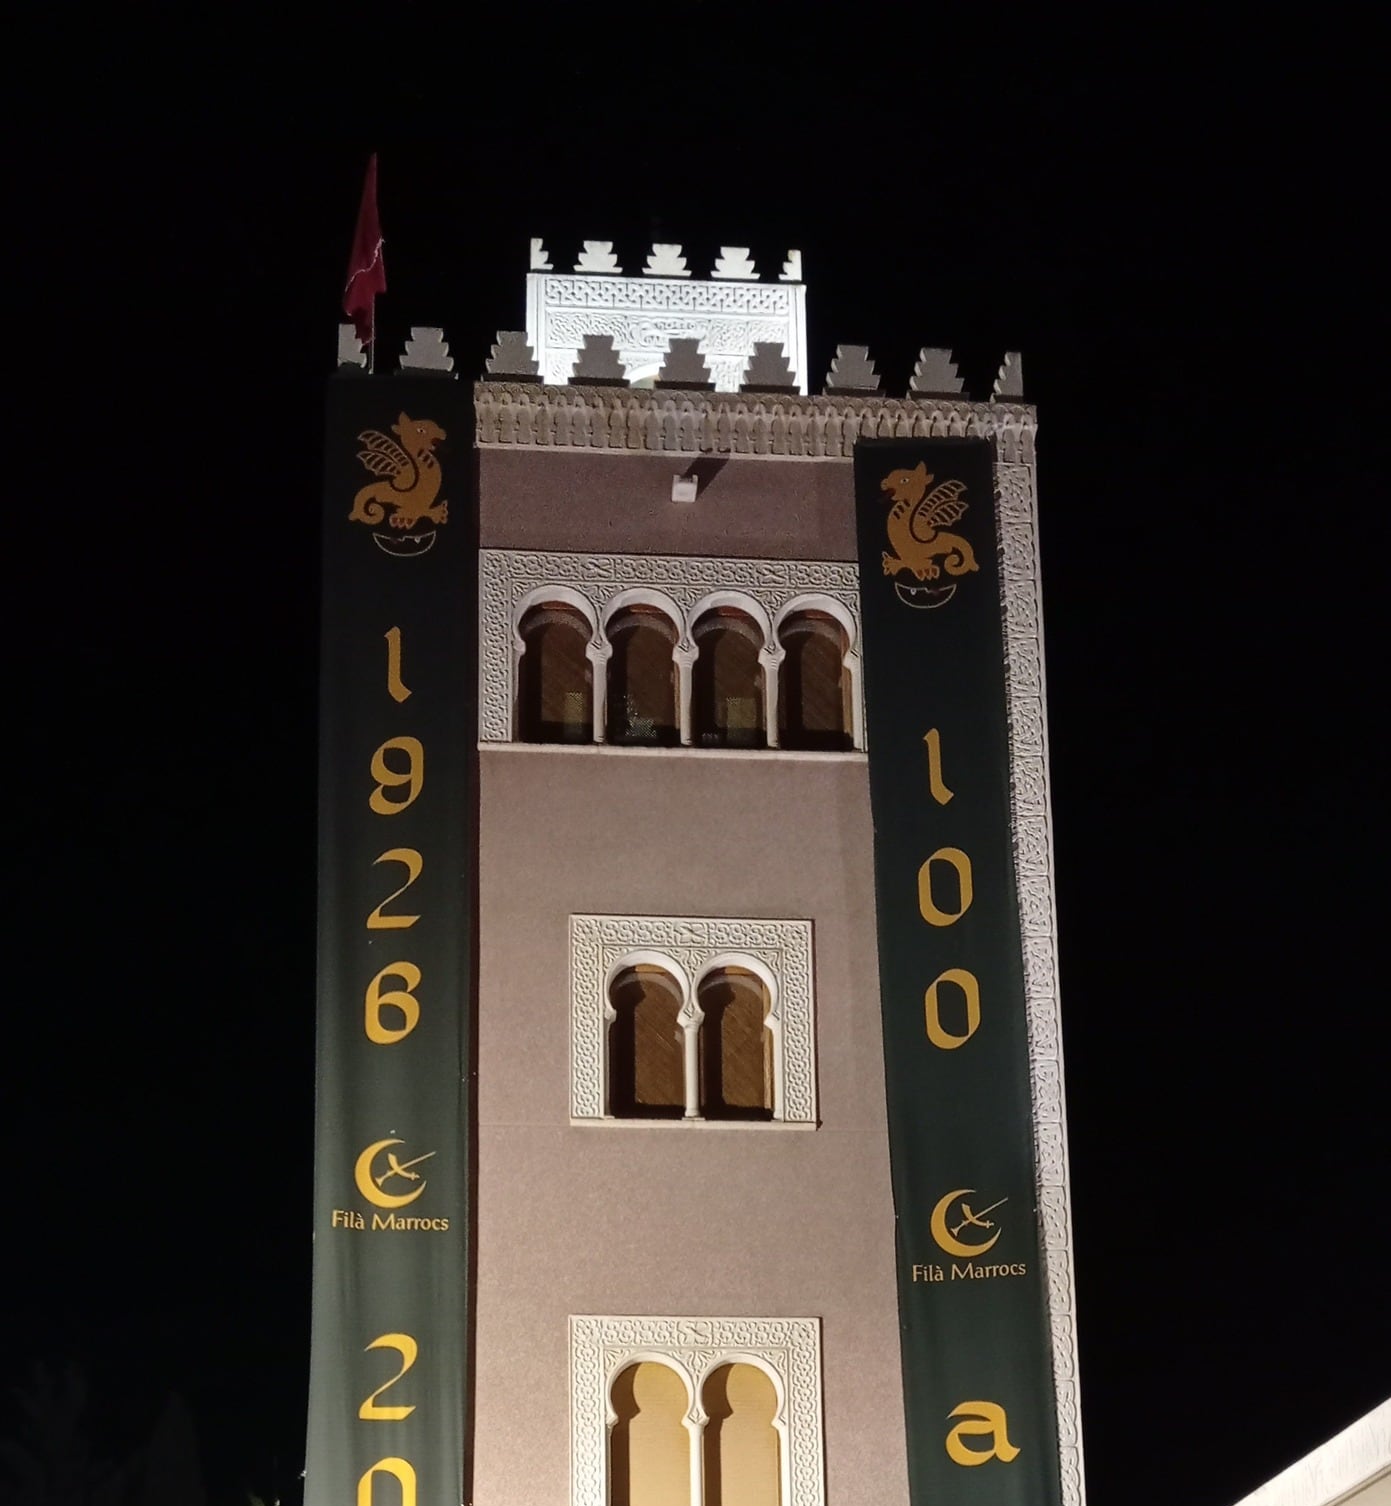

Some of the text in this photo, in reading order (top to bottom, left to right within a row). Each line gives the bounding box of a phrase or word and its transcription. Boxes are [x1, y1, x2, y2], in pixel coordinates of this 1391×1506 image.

[364, 625, 424, 1046] 1926
[917, 727, 982, 1051] 100
[331, 1209, 449, 1231] Filà Marrocs
[912, 1262, 1026, 1282] Filà Marrocs
